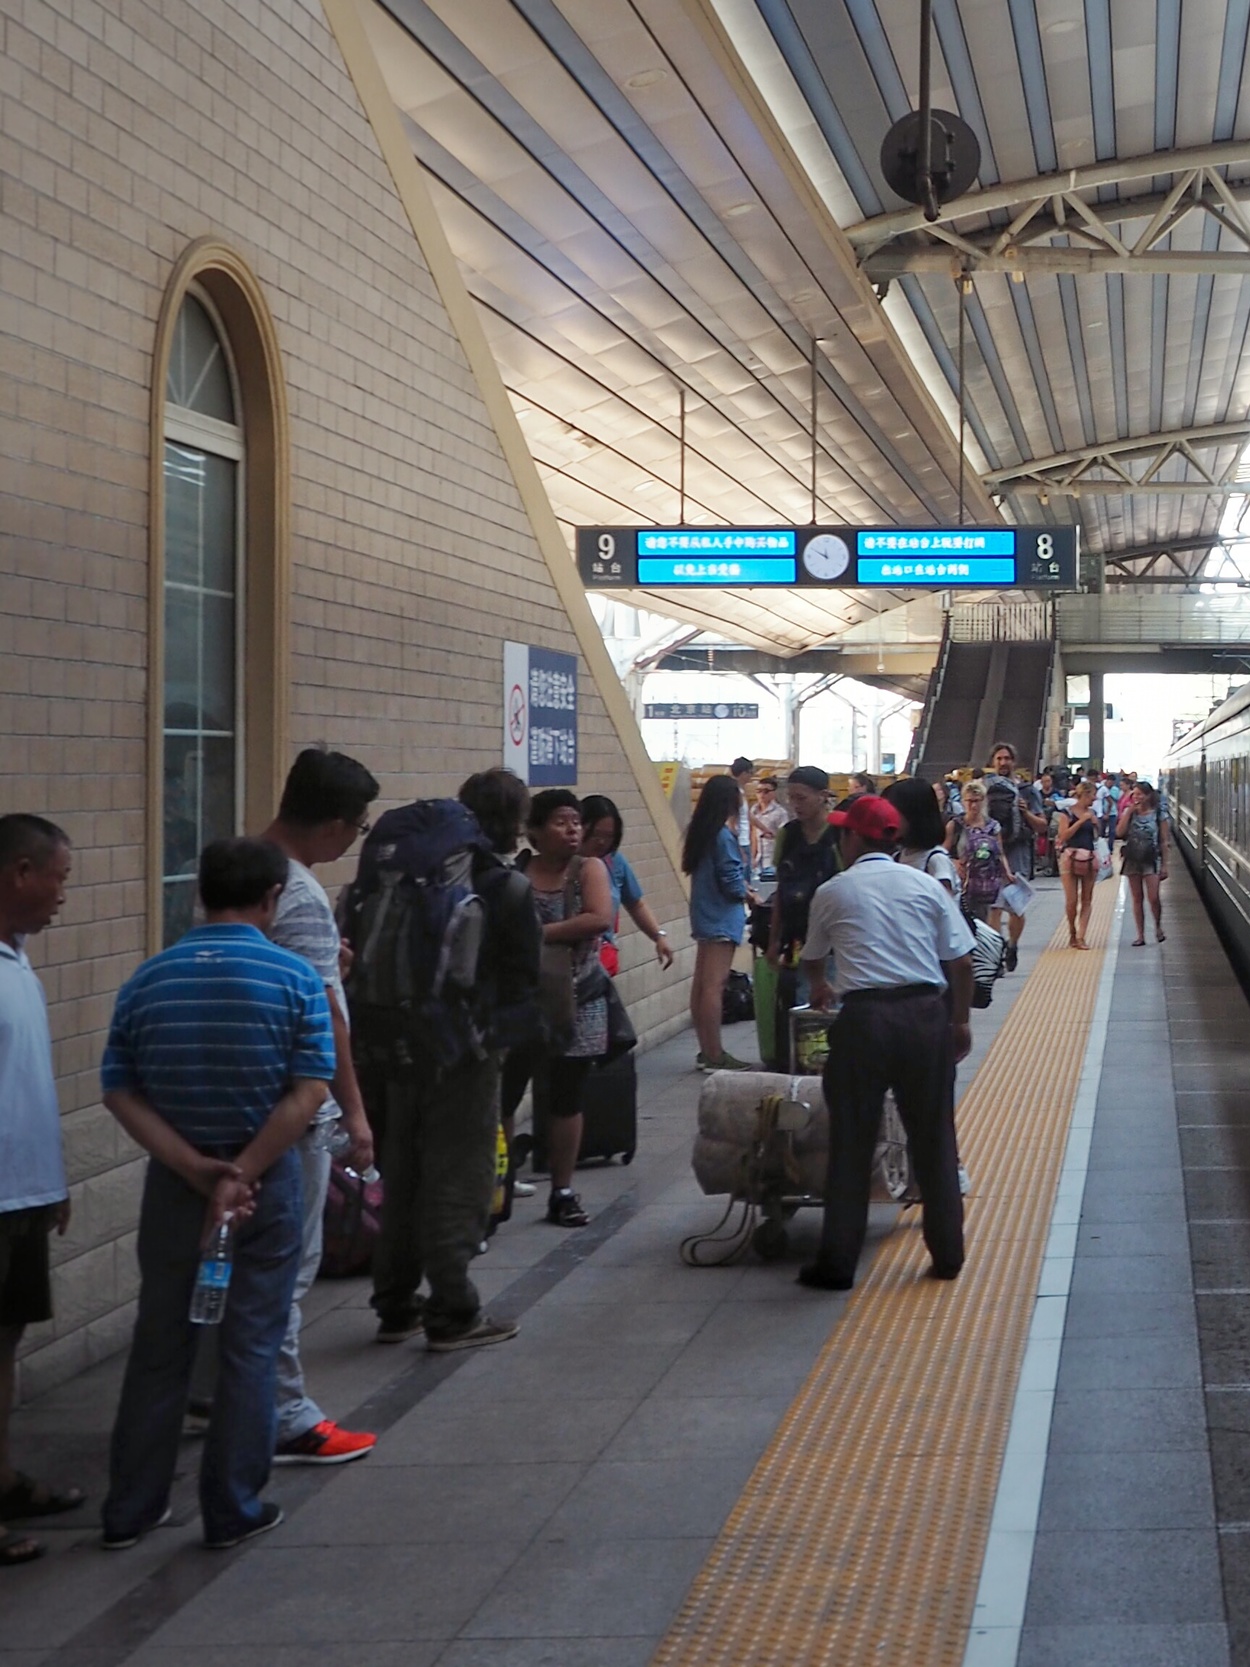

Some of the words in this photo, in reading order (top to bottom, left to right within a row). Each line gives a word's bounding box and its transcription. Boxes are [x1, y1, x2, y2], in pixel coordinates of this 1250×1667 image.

[598, 533, 615, 560] 9
[1037, 533, 1054, 559] 8
[592, 562, 621, 573] 站台
[1031, 561, 1060, 573] 站台
